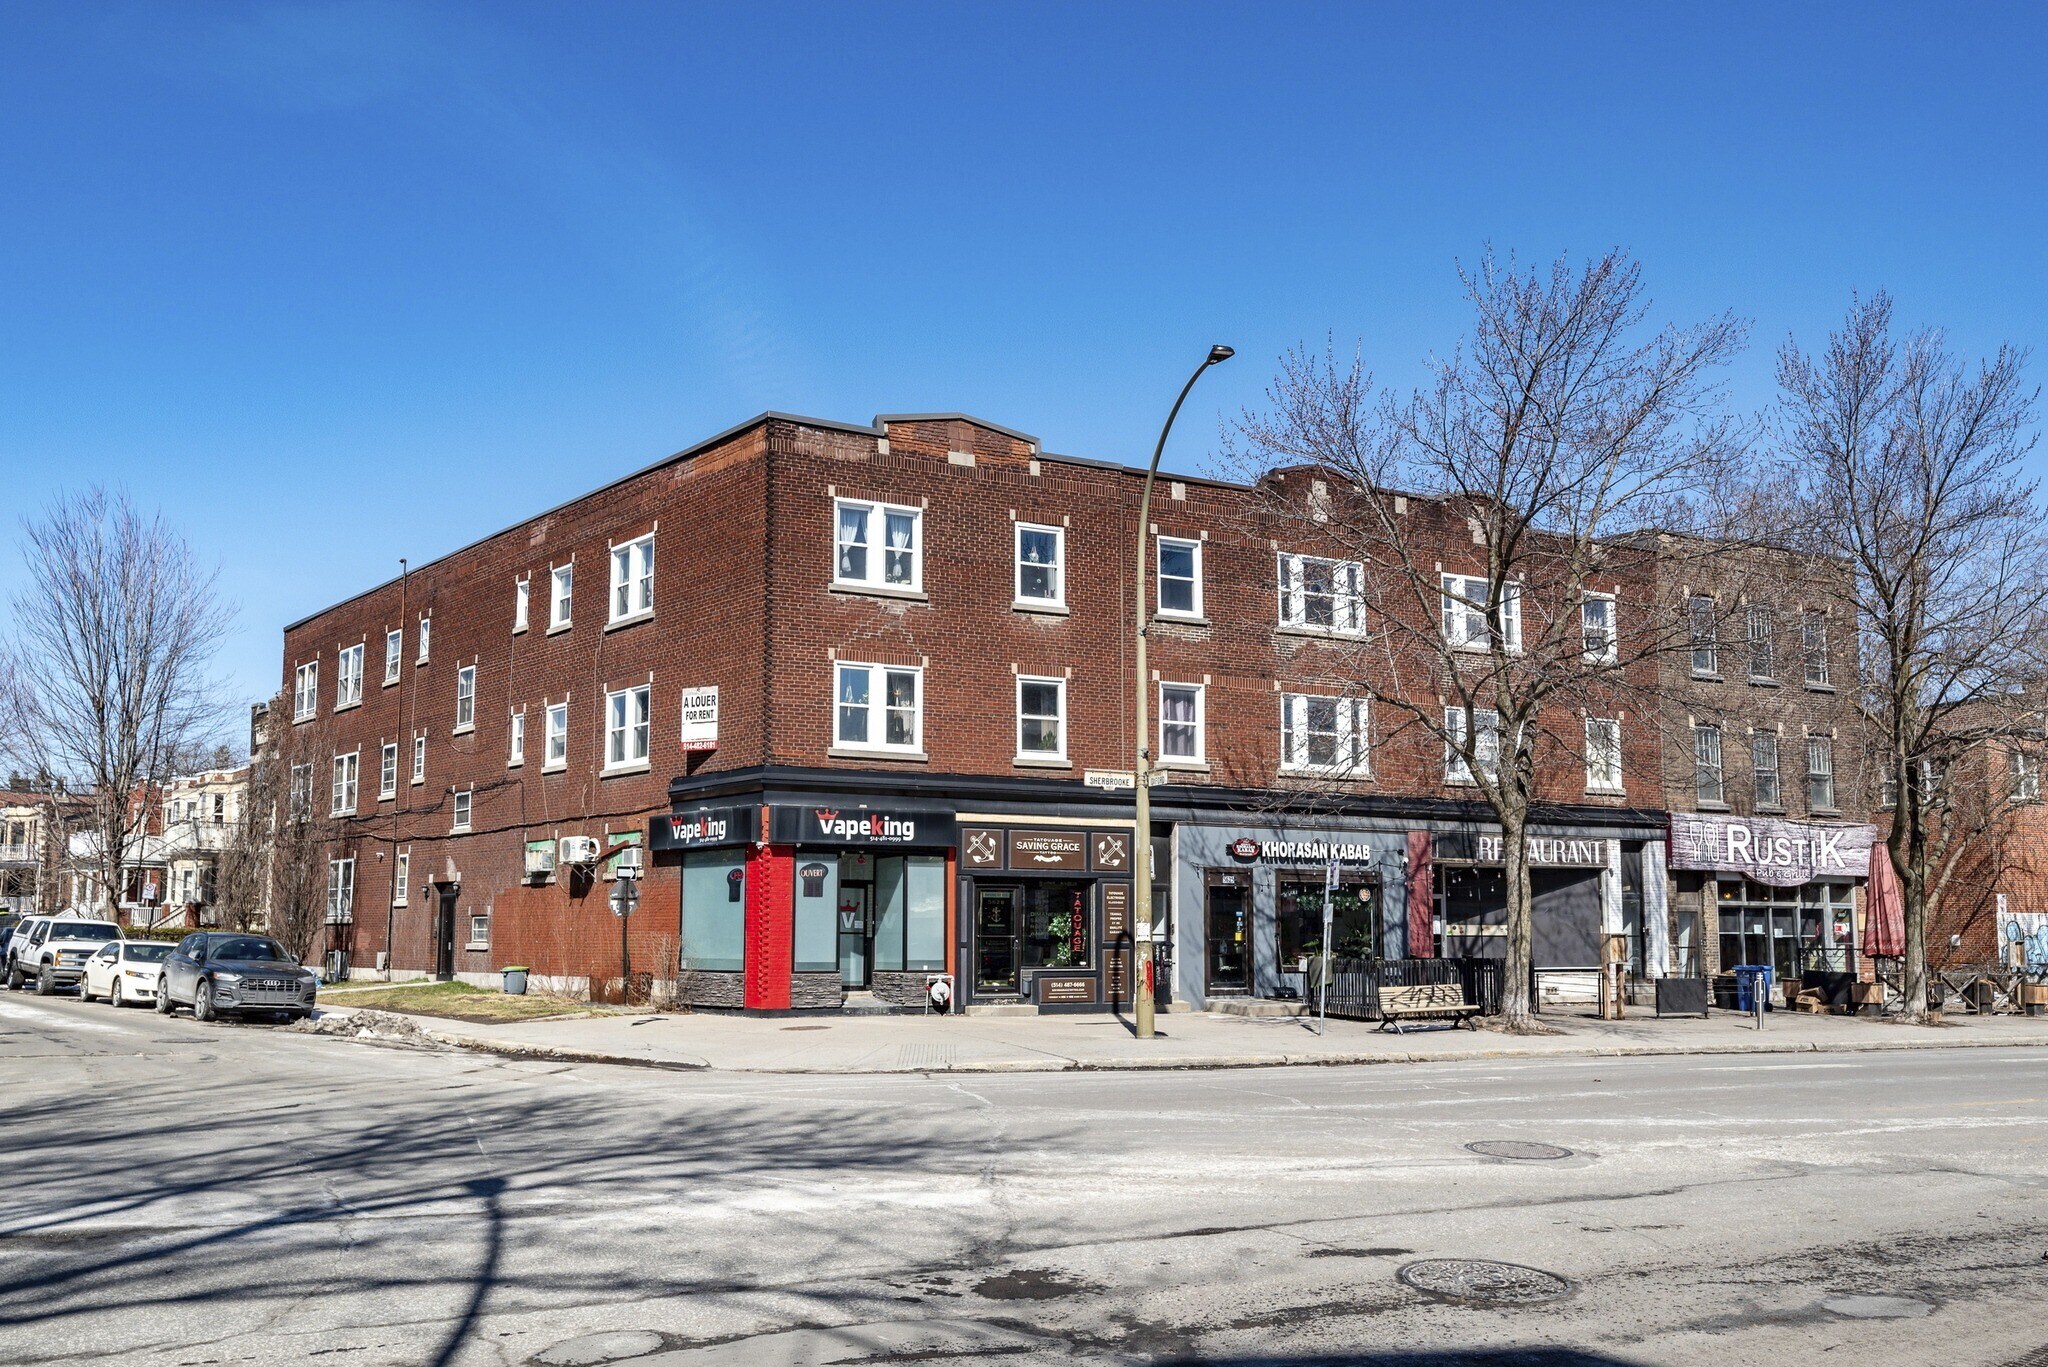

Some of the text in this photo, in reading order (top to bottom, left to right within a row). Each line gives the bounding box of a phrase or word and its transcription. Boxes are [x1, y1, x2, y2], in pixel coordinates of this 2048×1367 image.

[684, 695, 716, 708] A LOUER
[686, 709, 714, 720] FOR RENT
[1089, 776, 1130, 786] SHERBROOKE
[1016, 842, 1080, 851] SAVING GRACE
[1262, 841, 1371, 860] KHORASAN KABAB
[1479, 836, 1604, 864] REAURANT
[800, 869, 824, 877] OUVERT
[1756, 868, 1774, 877] Pub
[841, 912, 855, 928] V
[1073, 891, 1082, 952] TATOUAGE
